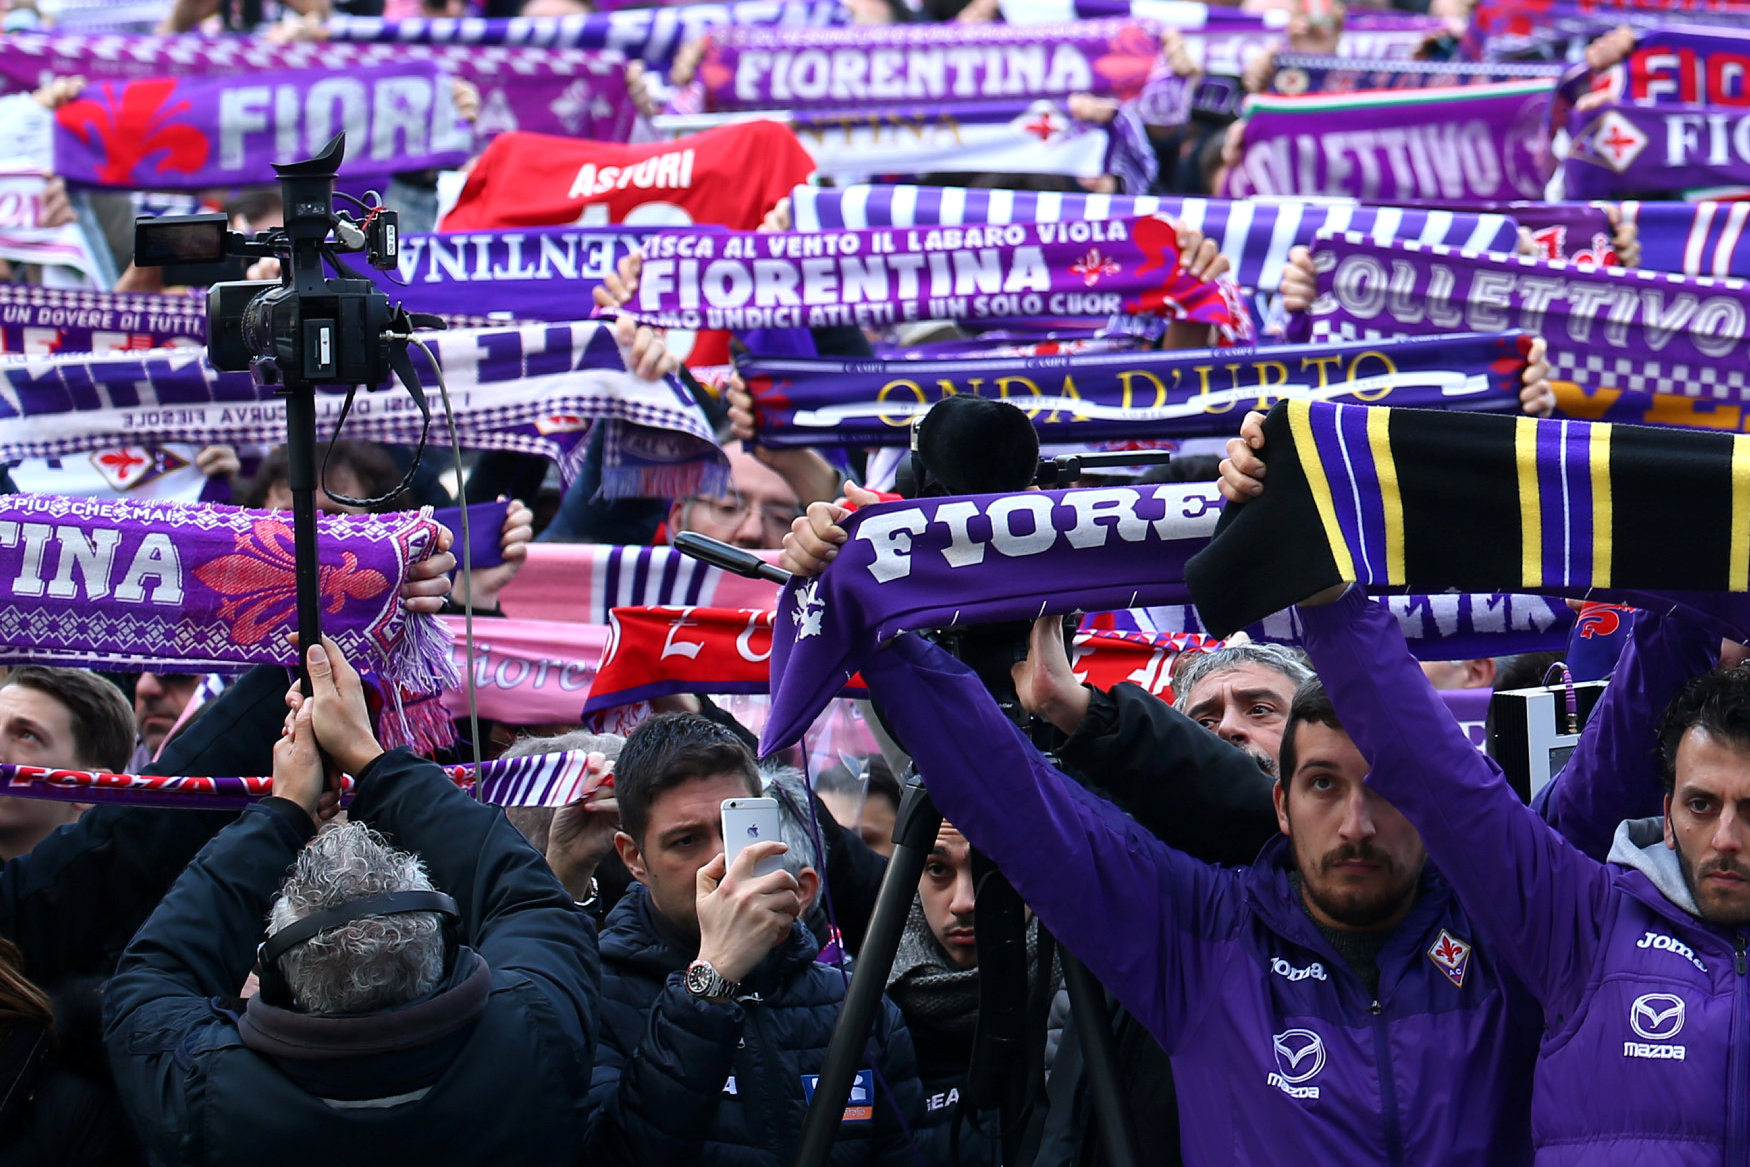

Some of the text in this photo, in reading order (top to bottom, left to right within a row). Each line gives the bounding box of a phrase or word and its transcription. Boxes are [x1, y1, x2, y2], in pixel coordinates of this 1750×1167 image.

[734, 43, 1093, 102] FIORENTINA
[568, 148, 696, 200] ASTORI
[724, 236, 758, 259] AL
[767, 235, 861, 258] VENTO
[871, 233, 895, 255] IL
[906, 224, 1026, 253] LABARO
[1036, 218, 1128, 245] VIOLA
[637, 246, 1052, 314] FIORENTINA
[3, 306, 32, 324] UN
[37, 307, 113, 329] DOVERE
[120, 312, 140, 329] DI
[706, 308, 801, 331] UNDICI
[809, 300, 894, 329] ATLETI
[901, 297, 918, 323] E
[929, 297, 970, 321] UN
[975, 294, 1041, 319] SOLO
[70, 503, 113, 518] CHE
[9, 766, 218, 796] FORZA
